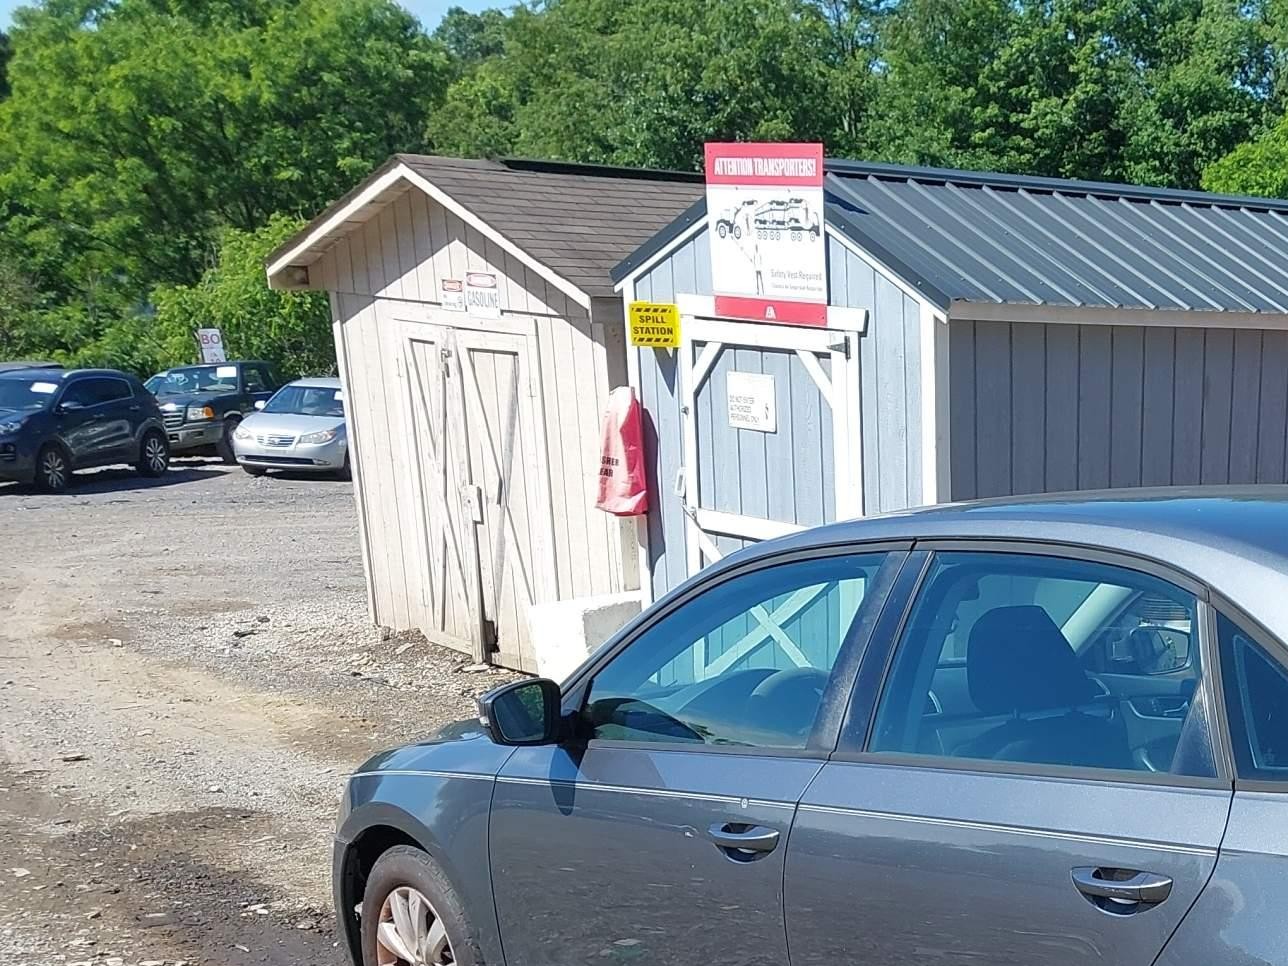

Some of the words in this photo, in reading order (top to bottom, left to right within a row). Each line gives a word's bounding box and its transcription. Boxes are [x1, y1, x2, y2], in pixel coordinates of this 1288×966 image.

[714, 157, 754, 176] ATTENTION
[754, 158, 817, 177] TRANSPORTERS!
[638, 315, 667, 324] SPILL
[632, 326, 674, 336] STATION
